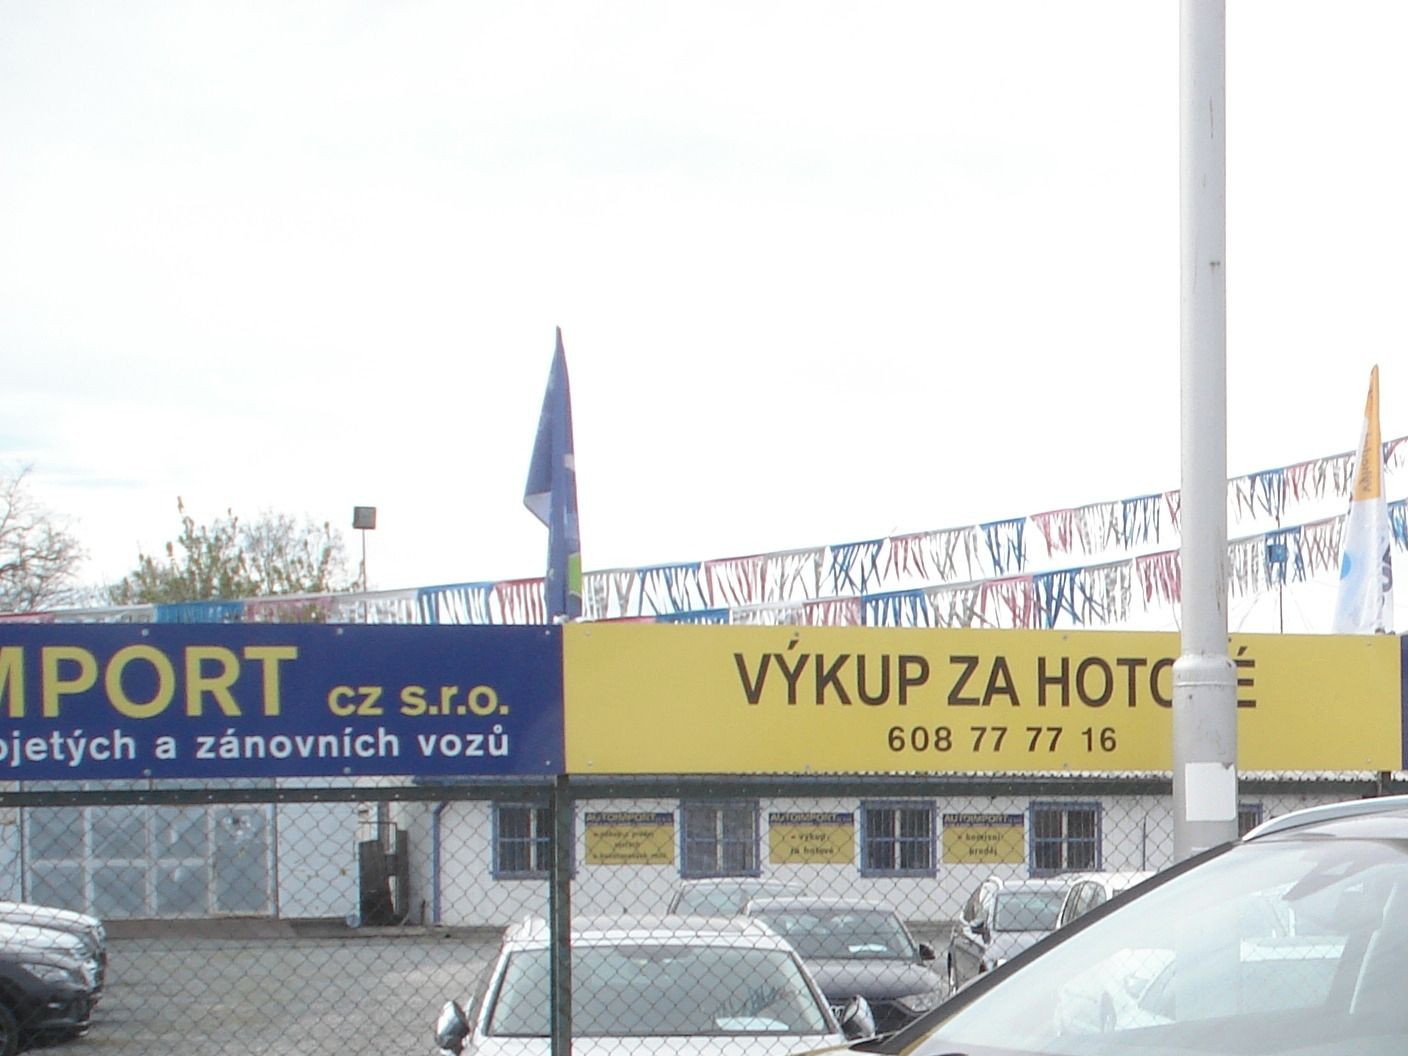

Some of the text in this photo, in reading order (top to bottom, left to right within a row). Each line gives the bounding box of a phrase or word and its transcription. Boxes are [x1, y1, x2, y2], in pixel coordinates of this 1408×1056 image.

[733, 640, 1257, 708] VÝKUP ZA HOTOÉ
[328, 685, 383, 716] cz
[400, 685, 509, 716] s.r.o.
[155, 736, 177, 759] a
[196, 727, 400, 759] zánovních
[418, 724, 509, 757] vozů
[888, 726, 1117, 752] 608 77 77 16
